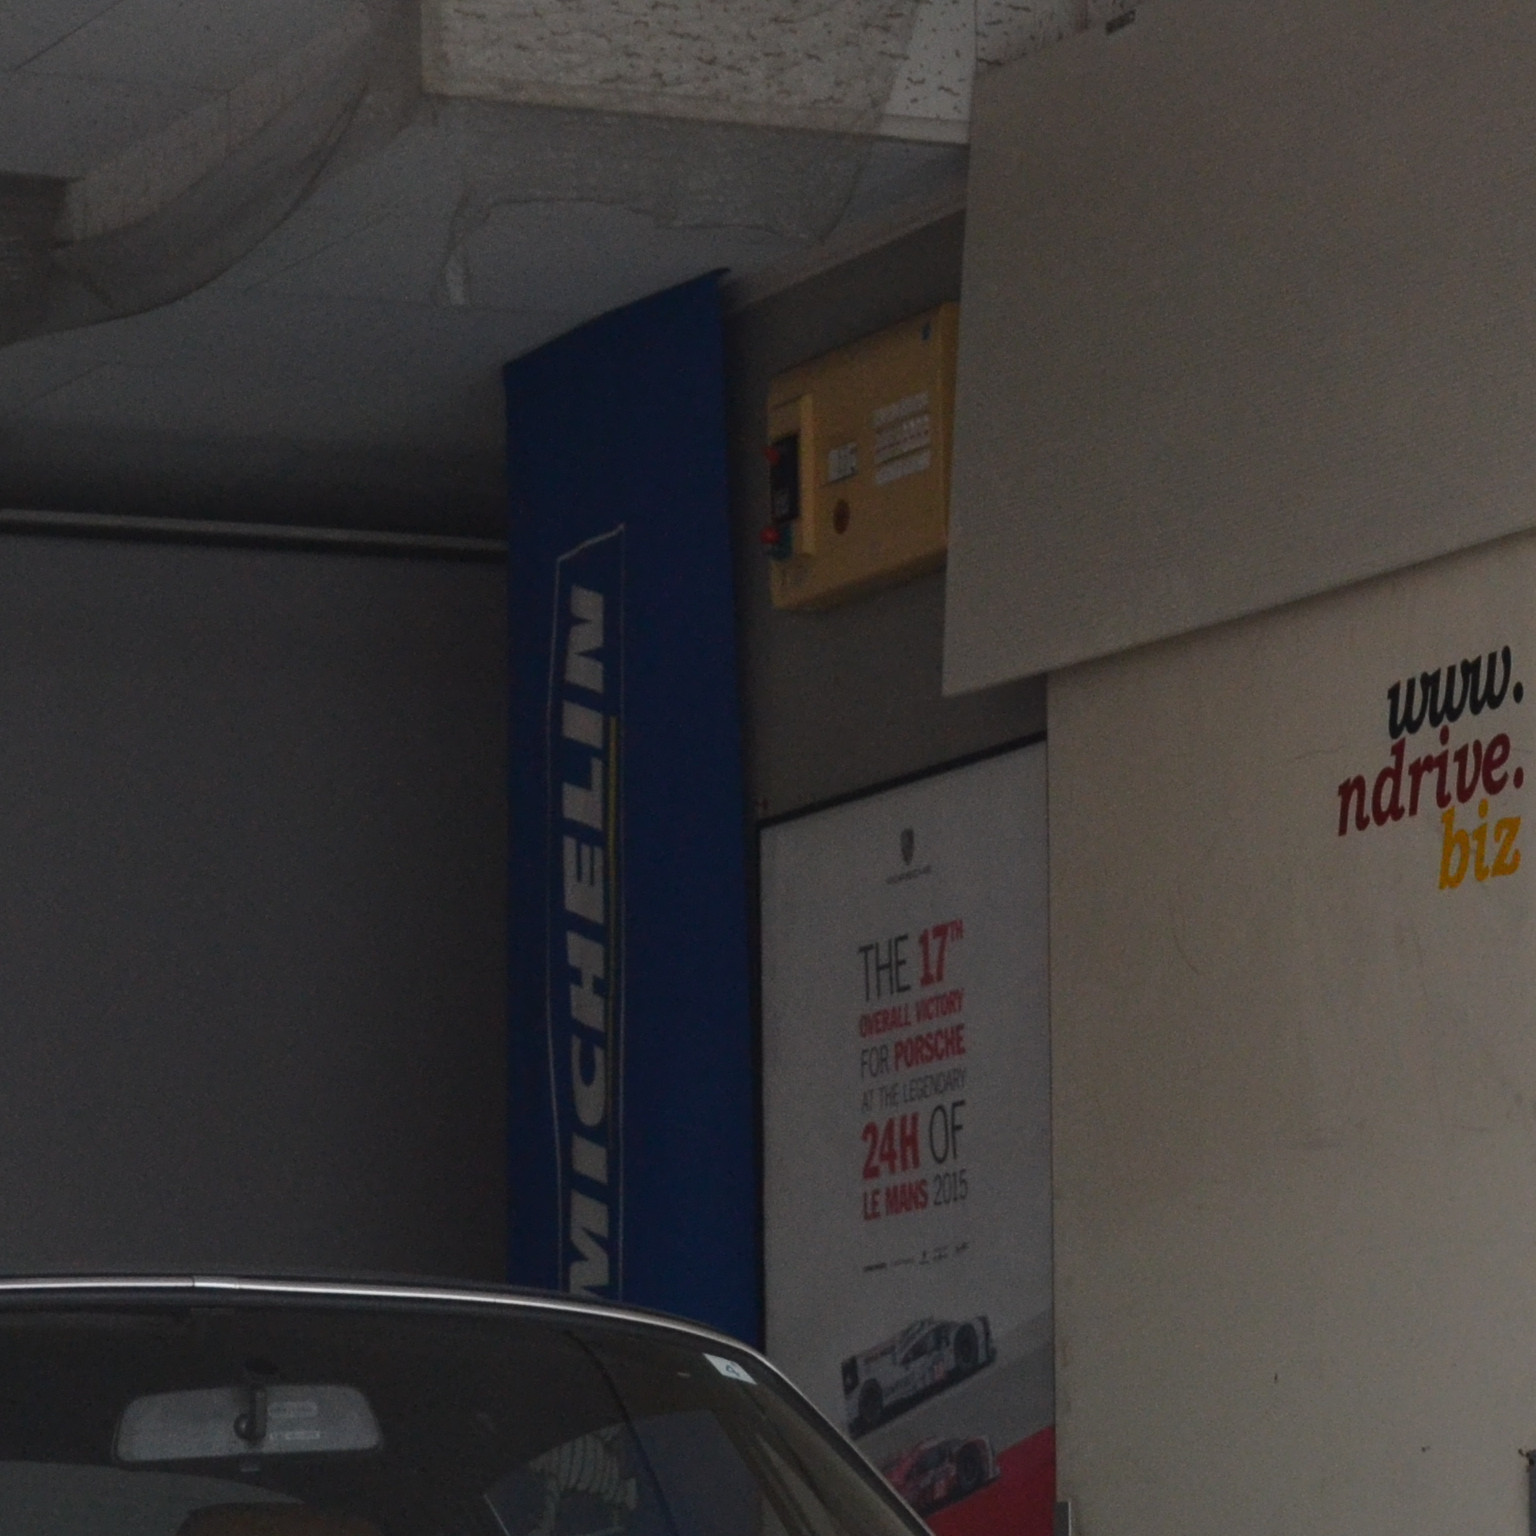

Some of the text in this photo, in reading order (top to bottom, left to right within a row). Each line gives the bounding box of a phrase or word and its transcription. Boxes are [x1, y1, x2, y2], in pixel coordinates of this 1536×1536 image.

[1386, 645, 1524, 740] www.
[1337, 725, 1524, 837] ndrive.
[1438, 799, 1523, 890] biz
[563, 584, 611, 1298] MICHELIN
[858, 933, 912, 1002] THE
[859, 987, 965, 1038] OVERALL VICTORY
[860, 1023, 966, 1079] FOR PORSCHE
[861, 1066, 967, 1113] AT THE LEGENDARY
[862, 1100, 967, 1181] 24H OF
[863, 1168, 969, 1222] LE MANS 2015
